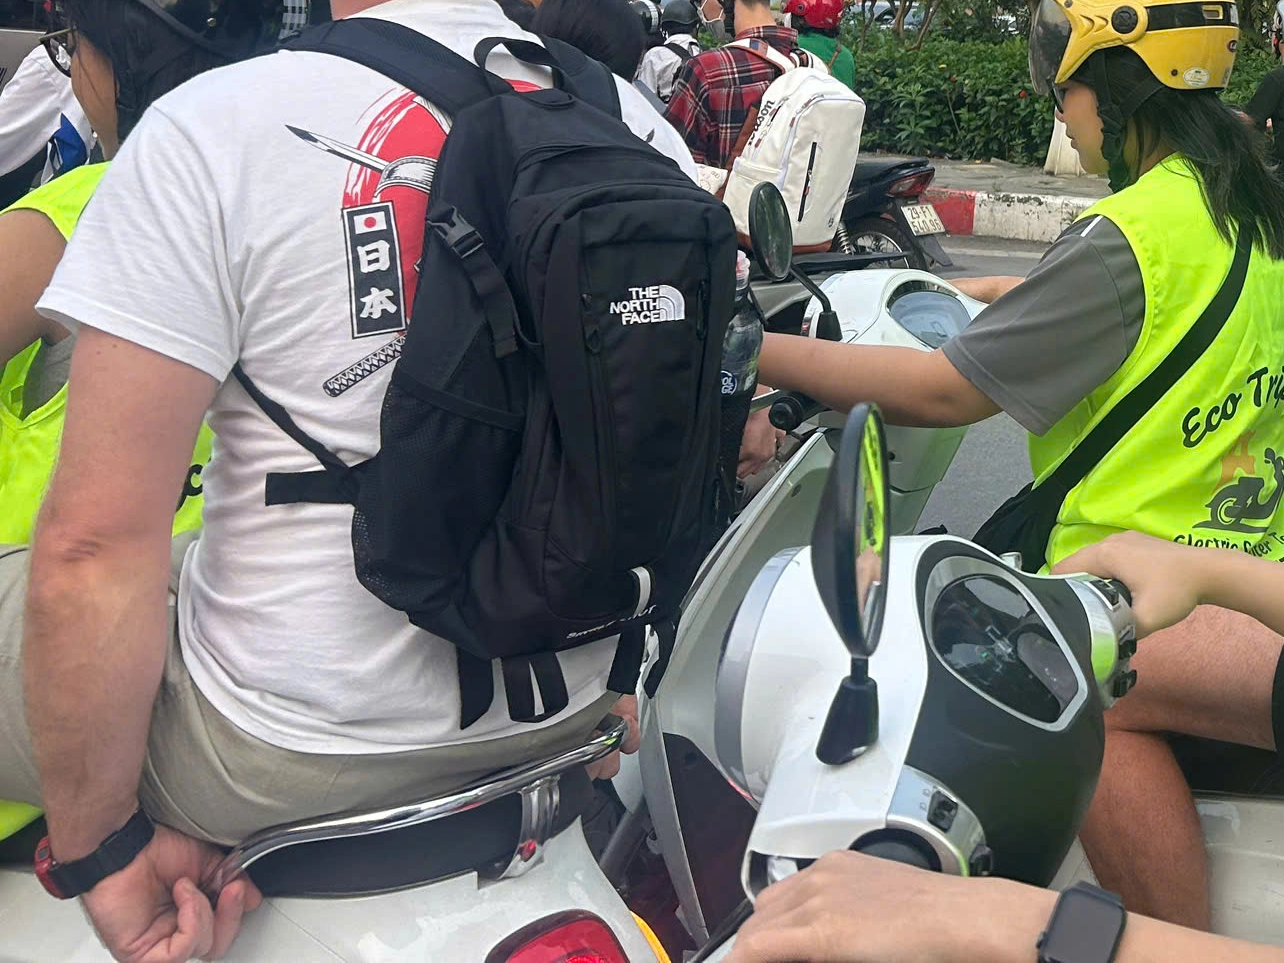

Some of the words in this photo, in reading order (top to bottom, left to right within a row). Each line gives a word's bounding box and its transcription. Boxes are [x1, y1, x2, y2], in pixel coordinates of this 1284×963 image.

[907, 205, 933, 220] 29-F1
[357, 239, 398, 320] 日本
[628, 285, 659, 300] THE
[609, 298, 659, 314] NORTH
[621, 310, 661, 326] FACE
[1182, 393, 1242, 448] Eco
